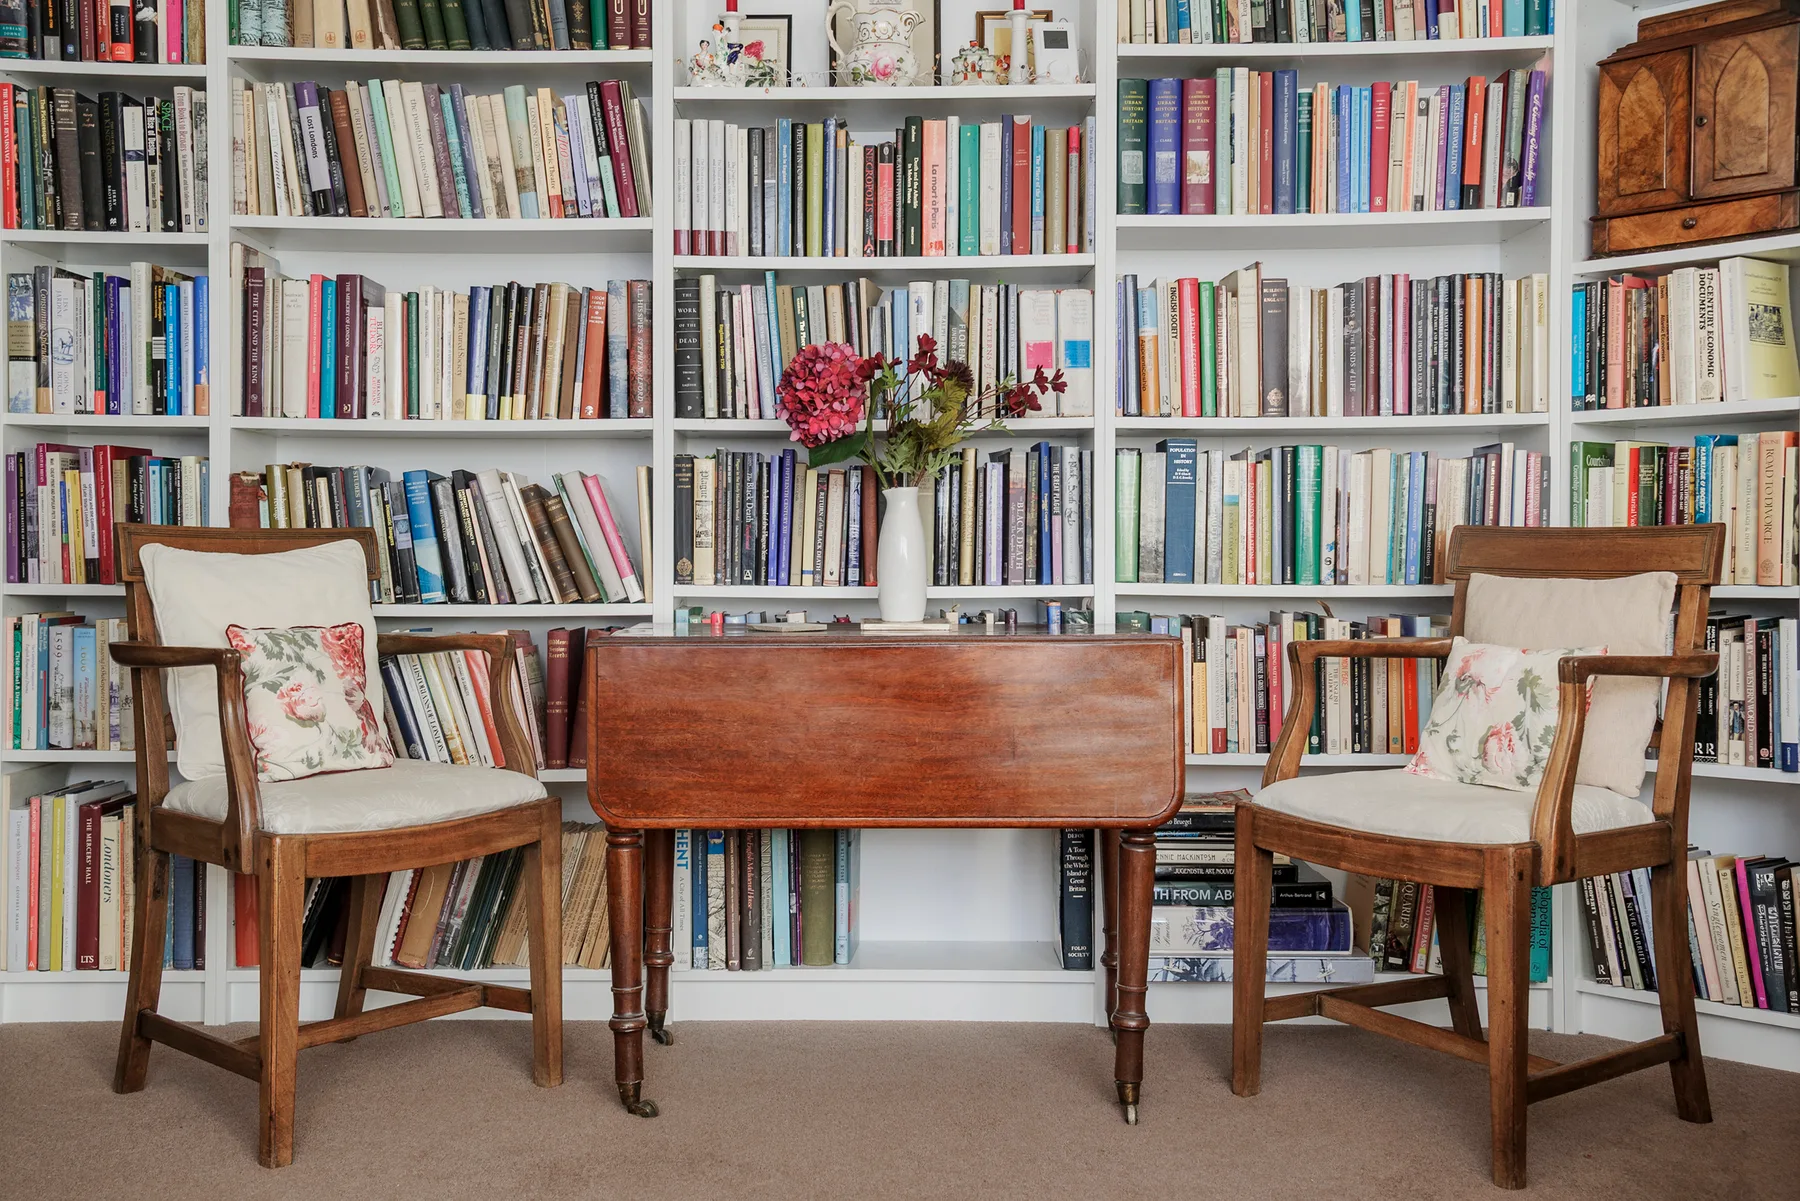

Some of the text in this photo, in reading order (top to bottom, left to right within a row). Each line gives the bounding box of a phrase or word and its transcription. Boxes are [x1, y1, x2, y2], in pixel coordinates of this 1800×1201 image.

[161, 101, 172, 132] SPACE
[309, 130, 318, 159] Londons
[354, 108, 369, 174] PURITAN LONDON
[797, 154, 803, 163] IN
[930, 164, 939, 175] La
[865, 147, 873, 213] NECROPOLIS
[930, 176, 939, 198] mort
[930, 207, 939, 229] Paris
[40, 287, 50, 365] Consuming Splendor
[1350, 366, 1356, 375] of
[1418, 361, 1423, 371] DO
[1418, 372, 1423, 380] US
[700, 469, 712, 499] Plague
[1764, 448, 1774, 544] ROAD TO DIVORCE
[412, 664, 444, 752] HISTORIANS OF LONDON
[677, 829, 688, 870] HENT
[102, 836, 114, 903] Londoners
[1173, 890, 1210, 900] FROM
[1587, 880, 1596, 914] PROPERTY
[1627, 902, 1645, 964] NEVER MARRIED
[1712, 900, 1727, 961] Singlewomen
[78, 955, 92, 963] LTS
